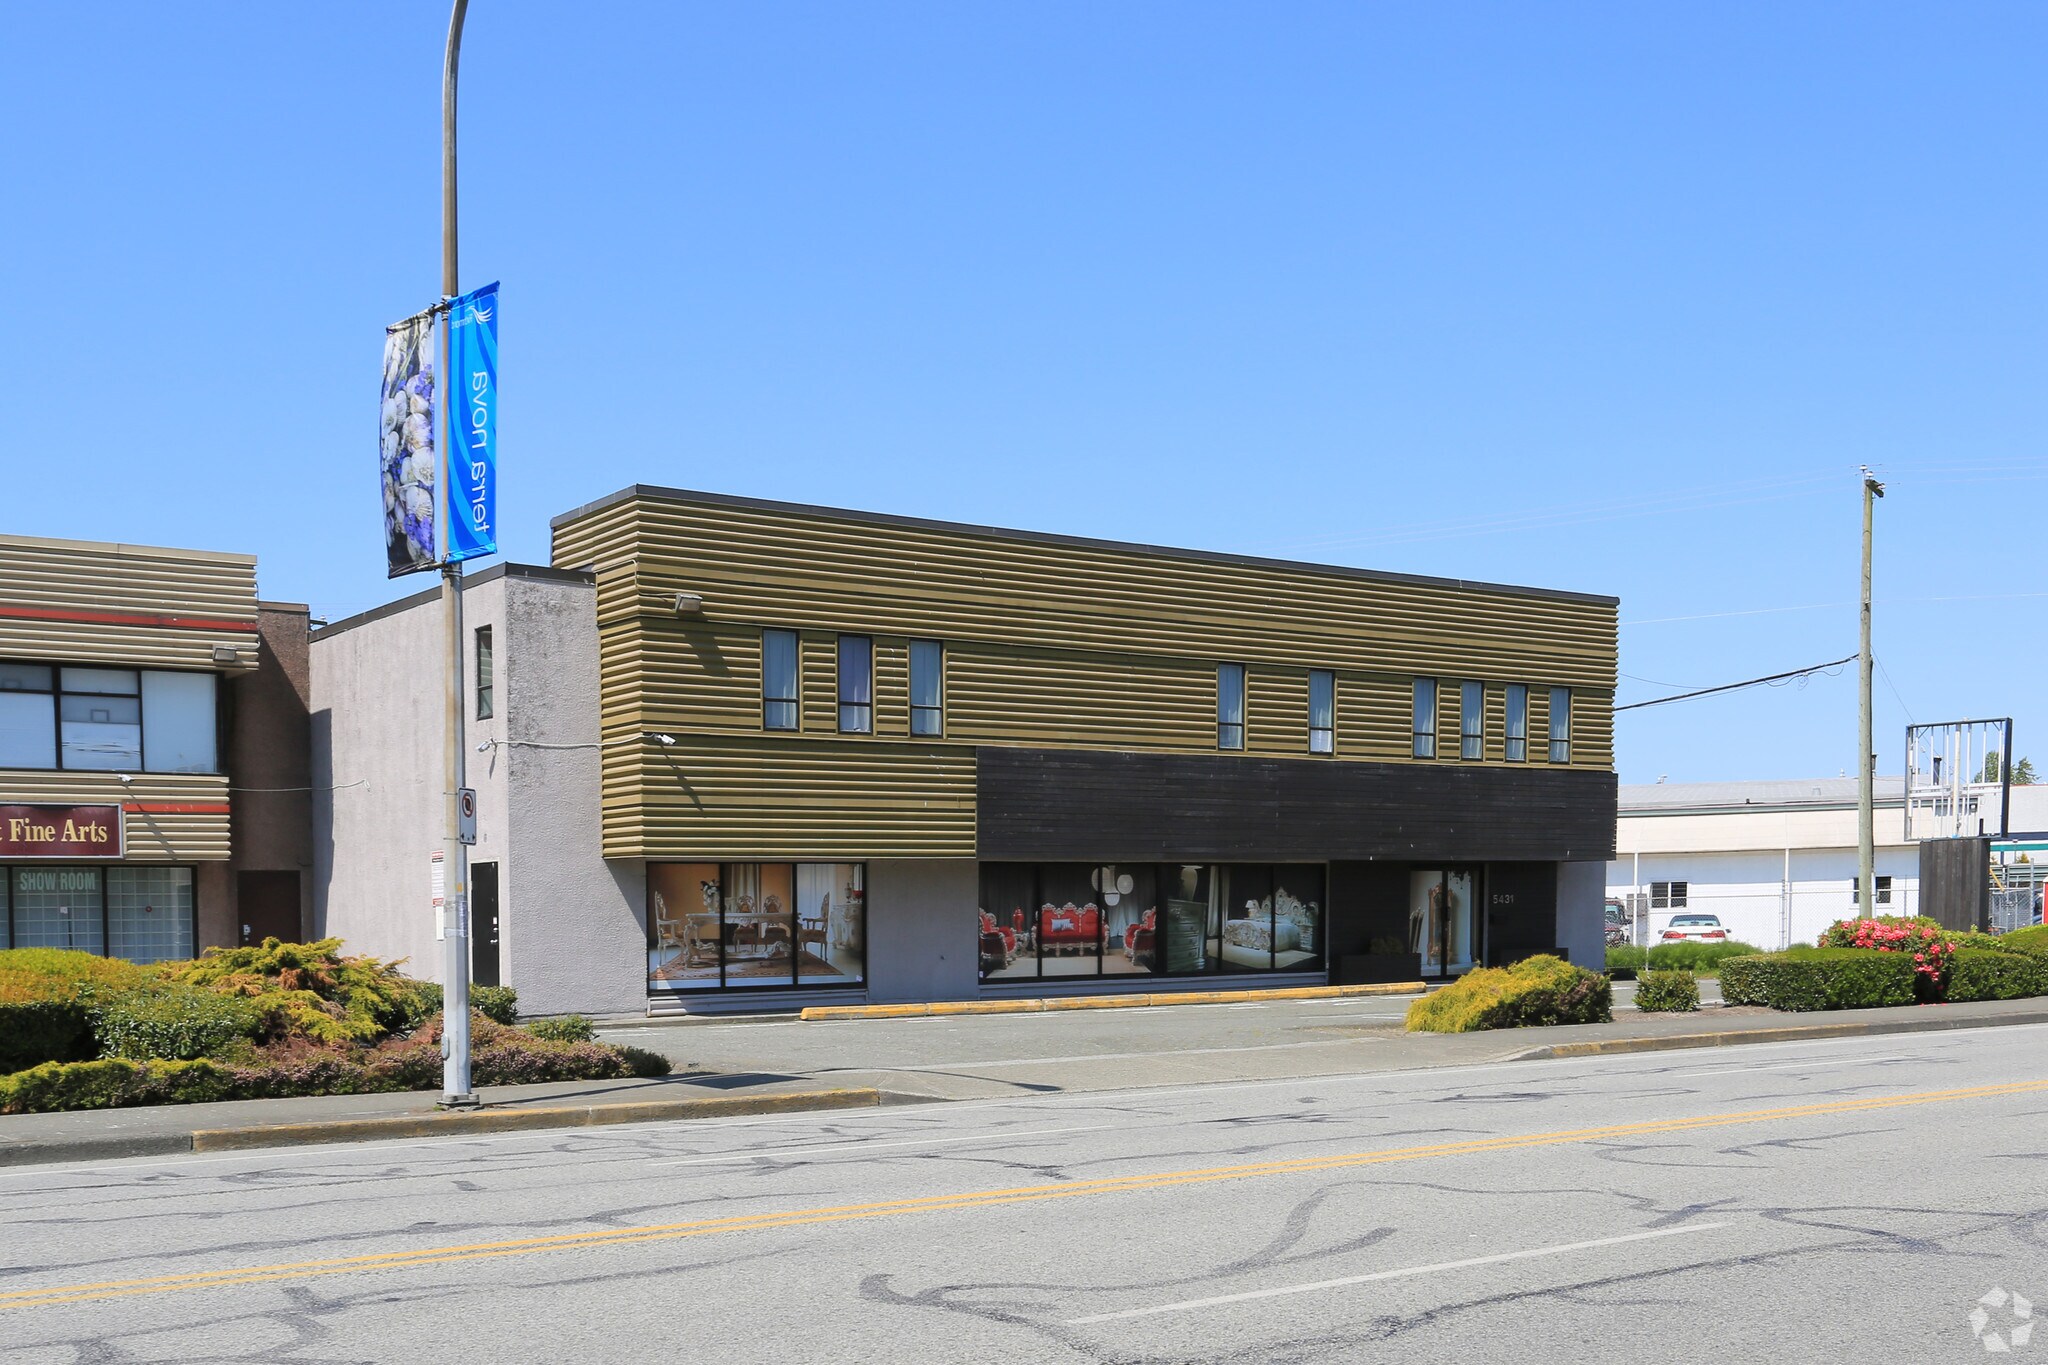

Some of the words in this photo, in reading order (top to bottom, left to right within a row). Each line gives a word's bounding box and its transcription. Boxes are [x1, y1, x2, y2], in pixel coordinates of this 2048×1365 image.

[9, 818, 56, 842] Fine
[60, 819, 108, 842] Arts
[20, 872, 56, 891] SHOW
[60, 872, 96, 891] ROOM
[1492, 894, 1514, 904] 5431
